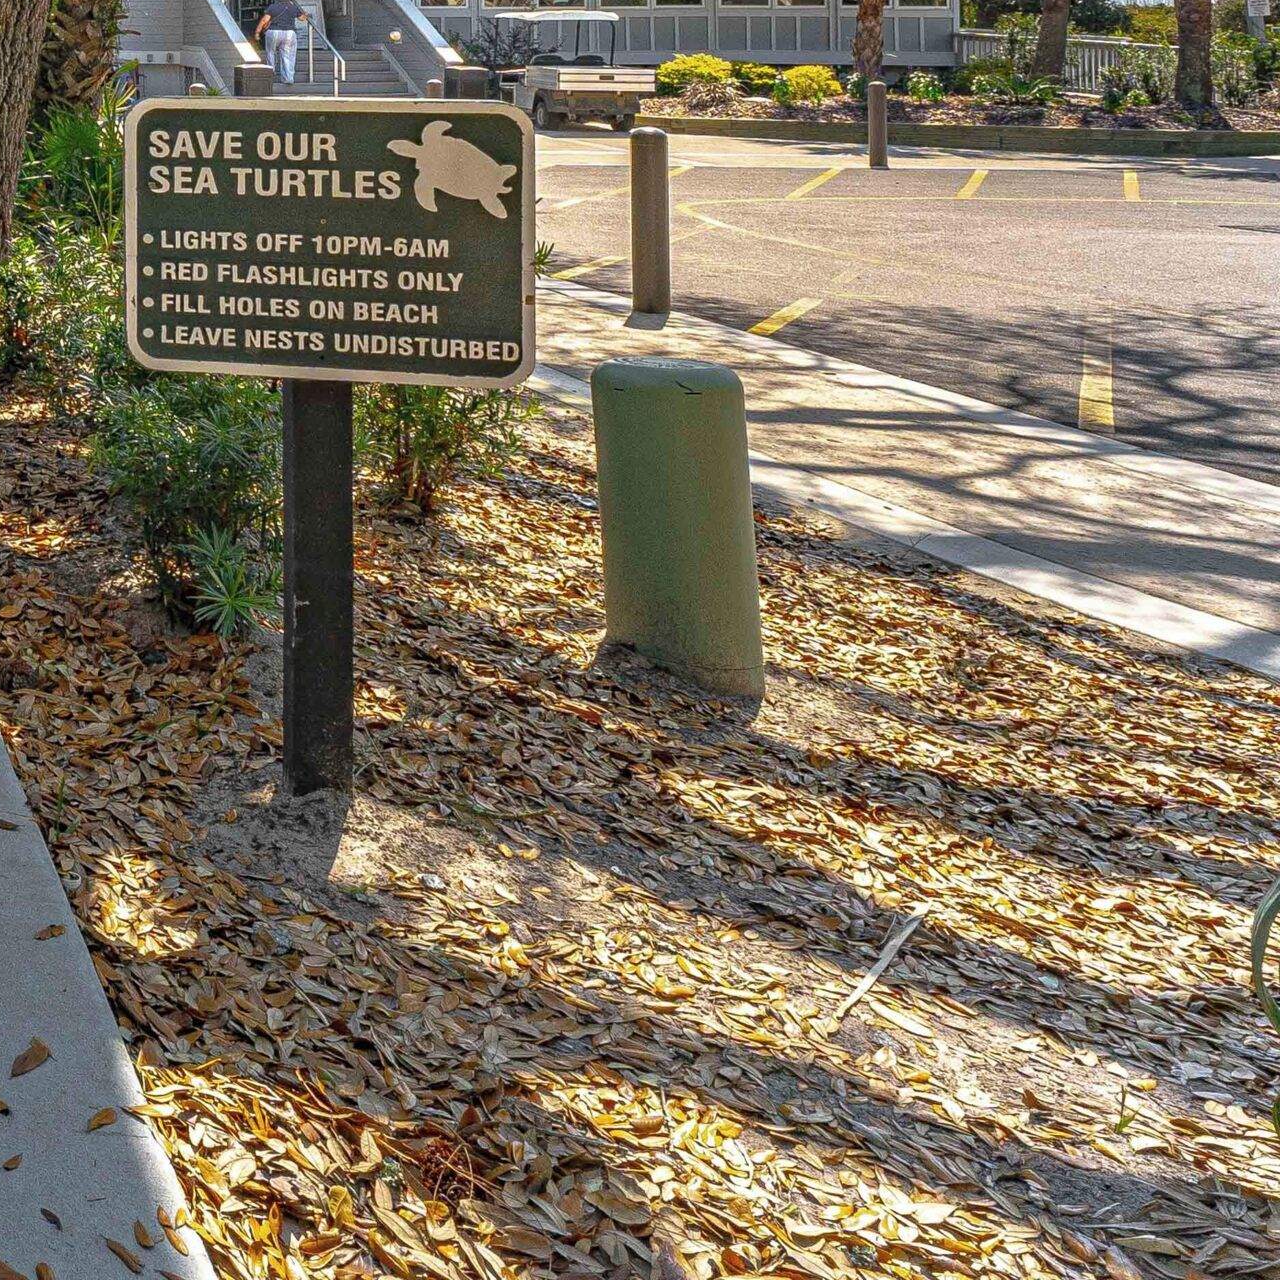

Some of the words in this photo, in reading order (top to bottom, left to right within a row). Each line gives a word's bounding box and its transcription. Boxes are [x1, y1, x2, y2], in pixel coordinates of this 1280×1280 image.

[149, 131, 242, 159] SAVE
[257, 132, 337, 161] OUR
[150, 166, 218, 194] SEA
[230, 168, 400, 199] TURTLES
[161, 230, 247, 251] LIGHTS
[256, 233, 303, 252] OFF
[312, 236, 448, 257] 10PM-6AM
[161, 262, 208, 281] RED
[218, 264, 388, 289] FLASHLIGHTS
[398, 271, 463, 291] ONLY
[162, 294, 210, 313] FILL
[220, 297, 299, 317] HOLES
[310, 300, 344, 319] ON
[354, 302, 438, 324] BEACH
[161, 325, 236, 346] LEAVE
[245, 329, 324, 351] NESTS
[334, 333, 519, 361] UNDISTURBED
